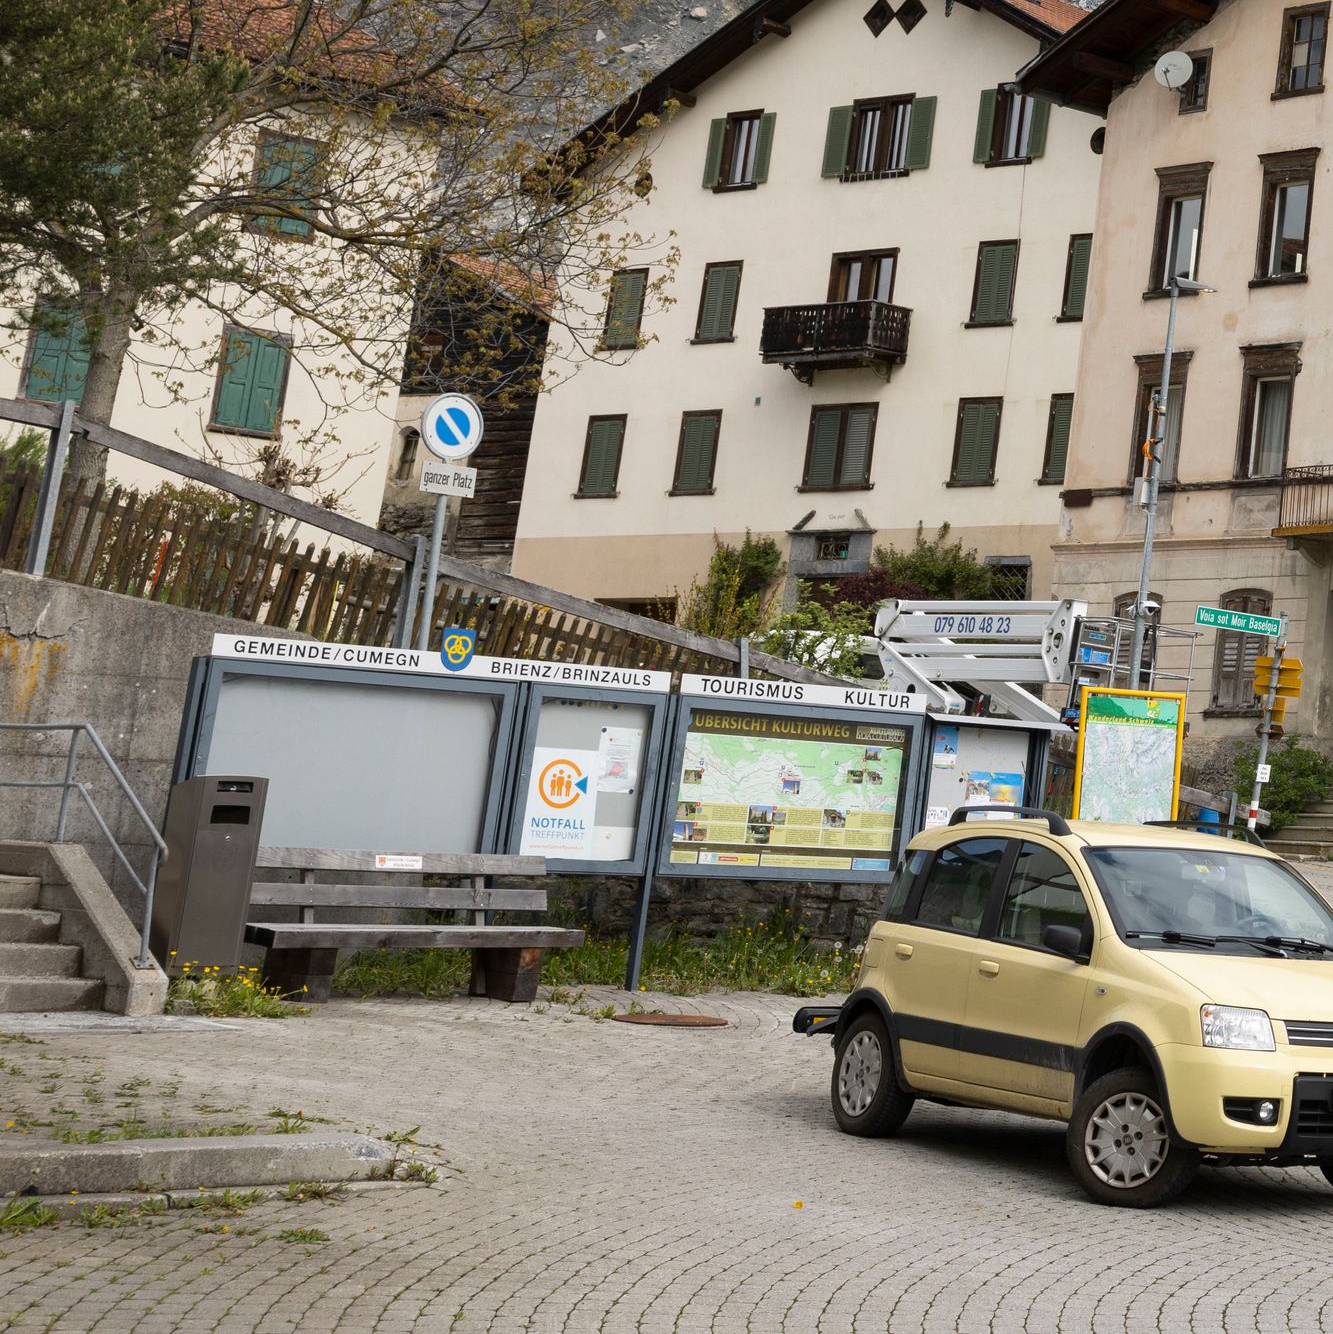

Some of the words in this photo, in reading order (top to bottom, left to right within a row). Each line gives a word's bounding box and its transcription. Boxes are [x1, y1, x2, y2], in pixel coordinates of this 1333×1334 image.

[424, 471, 450, 486] ganzer
[453, 472, 473, 489] Platz
[934, 616, 954, 633] 079
[957, 616, 975, 633] 610
[978, 616, 993, 633] 48
[995, 616, 1011, 633] 23
[1200, 610, 1214, 623] Voia
[1217, 614, 1229, 624] sot
[1231, 615, 1247, 627] Moir
[1249, 617, 1278, 634] Baselgia
[234, 640, 421, 667] GEMEINDE/CUMEGN
[491, 661, 652, 686] BRIENZ/BRINZAULS
[701, 678, 804, 700] TOURISMUS
[844, 691, 910, 709] KULTUR
[772, 720, 850, 738] KULTURWEG
[531, 817, 585, 830] NOTFALL
[531, 830, 585, 840] TREFFPUNKT
